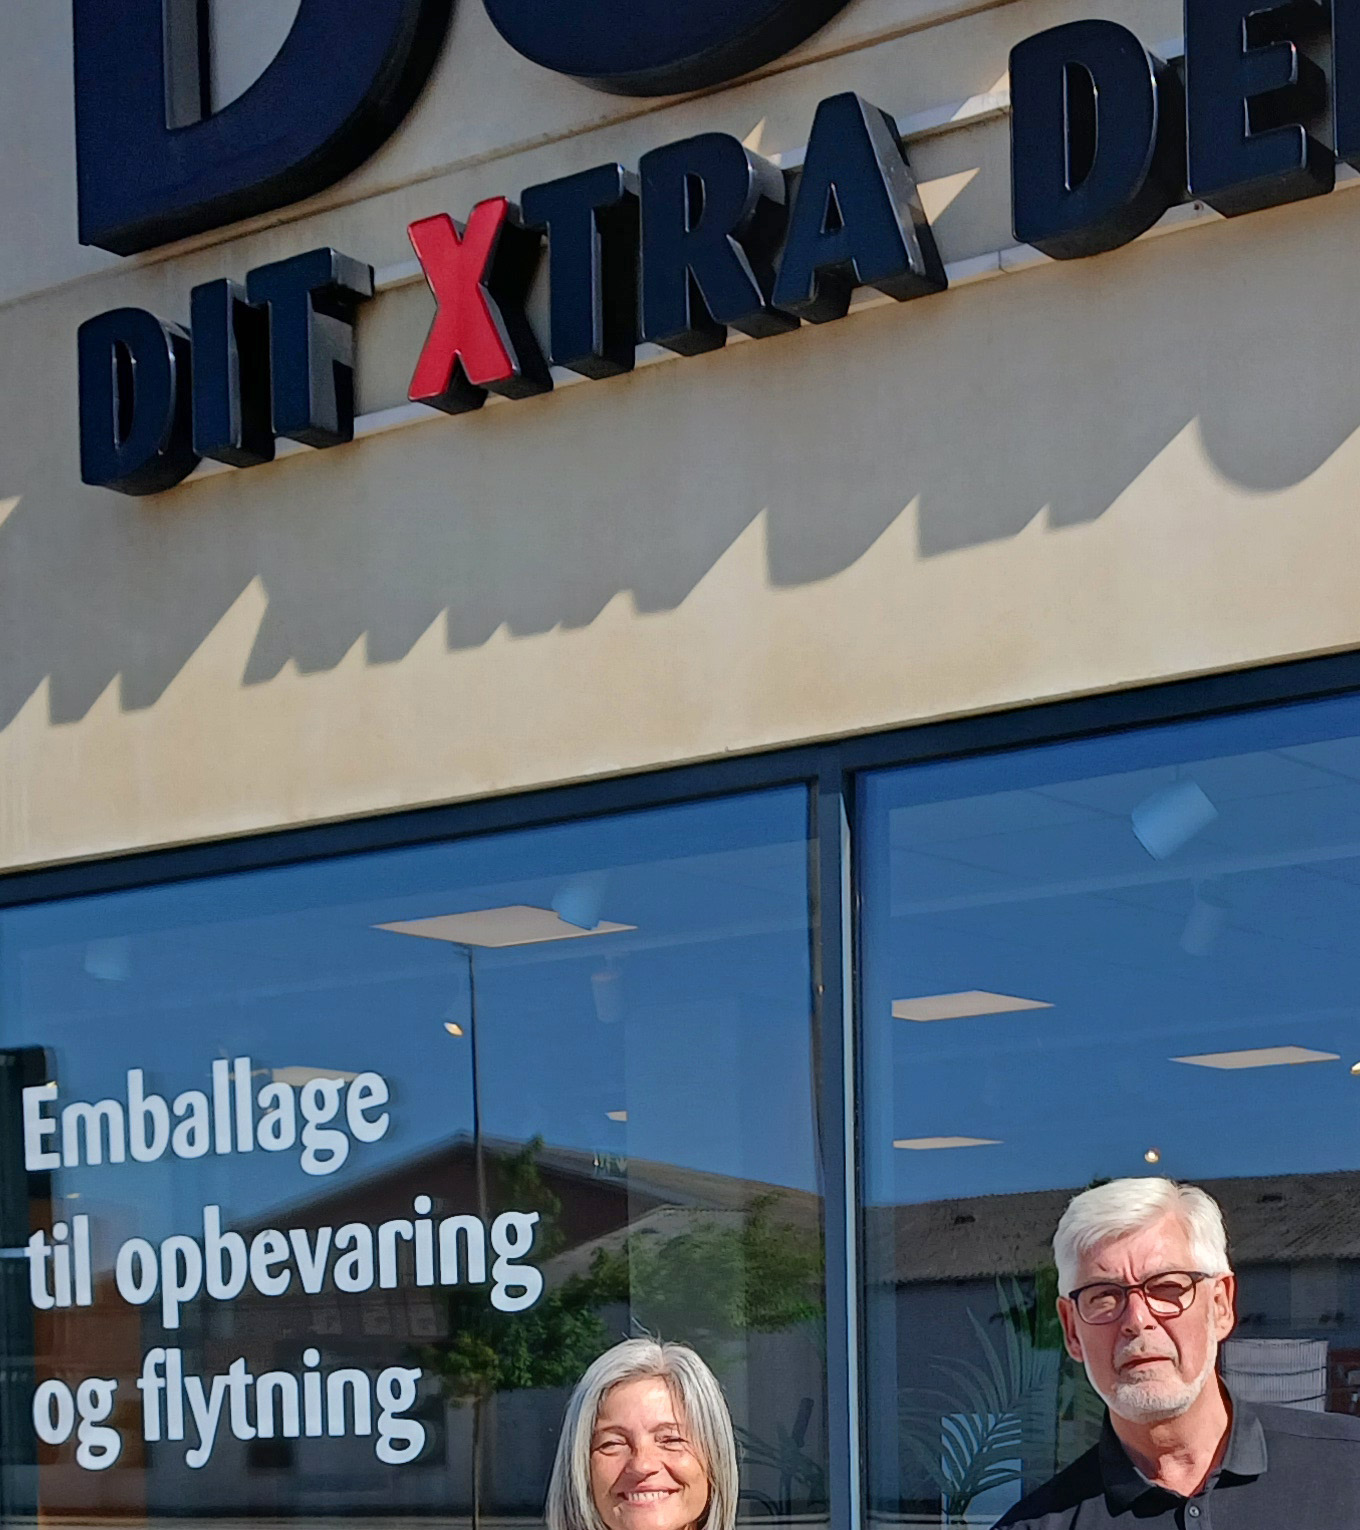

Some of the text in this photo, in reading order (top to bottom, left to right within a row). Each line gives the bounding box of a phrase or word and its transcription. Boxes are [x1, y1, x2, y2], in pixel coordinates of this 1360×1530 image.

[78, 247, 375, 496] DIT
[407, 91, 948, 416] XTRA
[22, 1056, 390, 1177] Emballage
[28, 1195, 543, 1330] til opbevaring
[32, 1348, 425, 1471] og flytning
